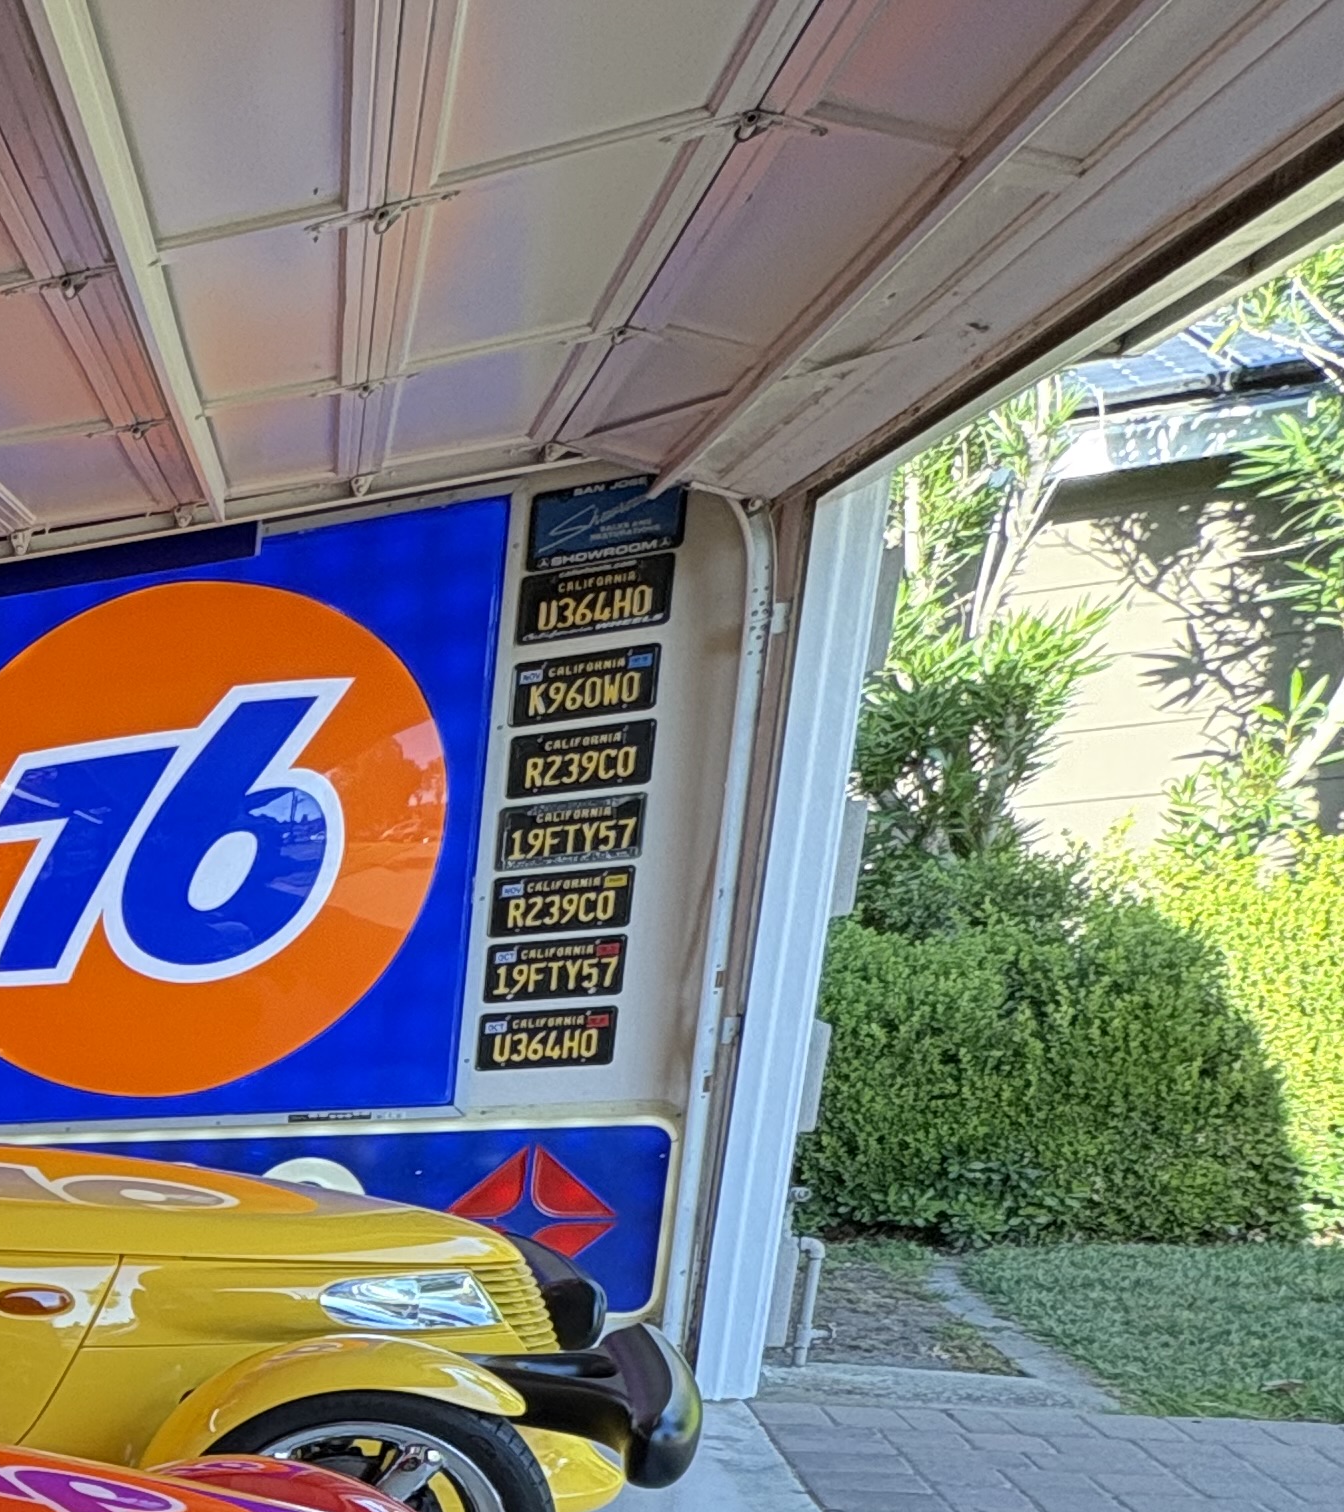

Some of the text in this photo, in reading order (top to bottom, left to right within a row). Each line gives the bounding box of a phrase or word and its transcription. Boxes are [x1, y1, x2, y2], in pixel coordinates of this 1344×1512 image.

[573, 484, 605, 497] SAN
[550, 539, 658, 567] SHOWROOM
[558, 571, 637, 593] CALIFORNIA
[548, 657, 626, 678] CALIFORNIA
[544, 731, 622, 751] CALIFORNIA
[536, 806, 612, 824] CALIFORNIA
[508, 816, 638, 861] 19FTY57
[526, 875, 602, 893] CALIFORNIA
[520, 944, 595, 960] CALIFORNIA
[492, 955, 619, 996] 19FTY57
[511, 1014, 585, 1030] CALIFORNIA
